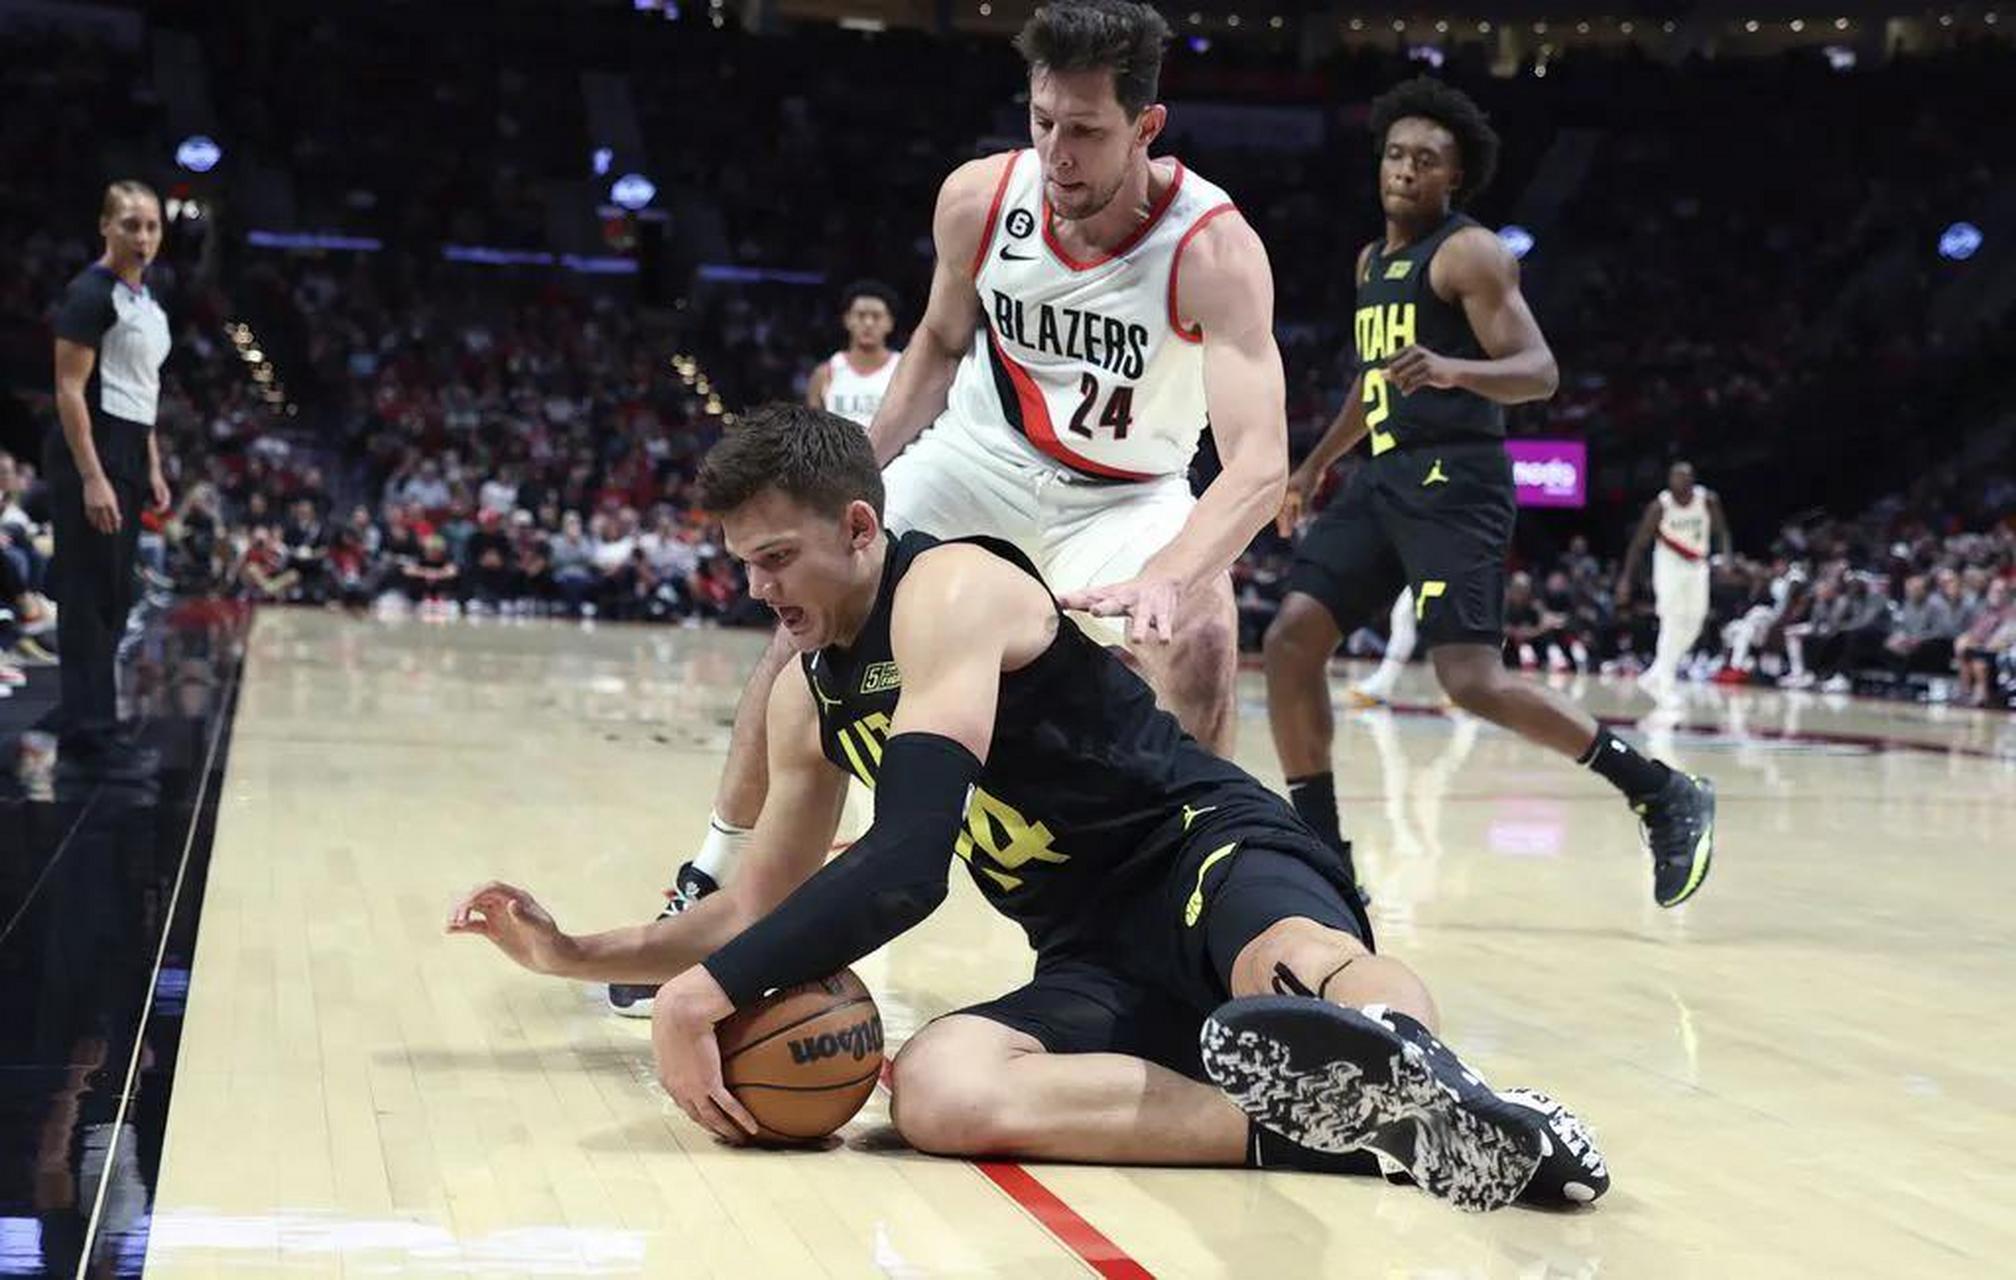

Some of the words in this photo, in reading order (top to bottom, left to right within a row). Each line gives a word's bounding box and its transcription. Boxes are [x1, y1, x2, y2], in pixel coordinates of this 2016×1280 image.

[1010, 211, 1030, 236] 6
[992, 289, 1149, 380] BLAZERS
[1069, 372, 1134, 440] 24
[1363, 368, 1397, 457] 2
[866, 665, 880, 689] 5
